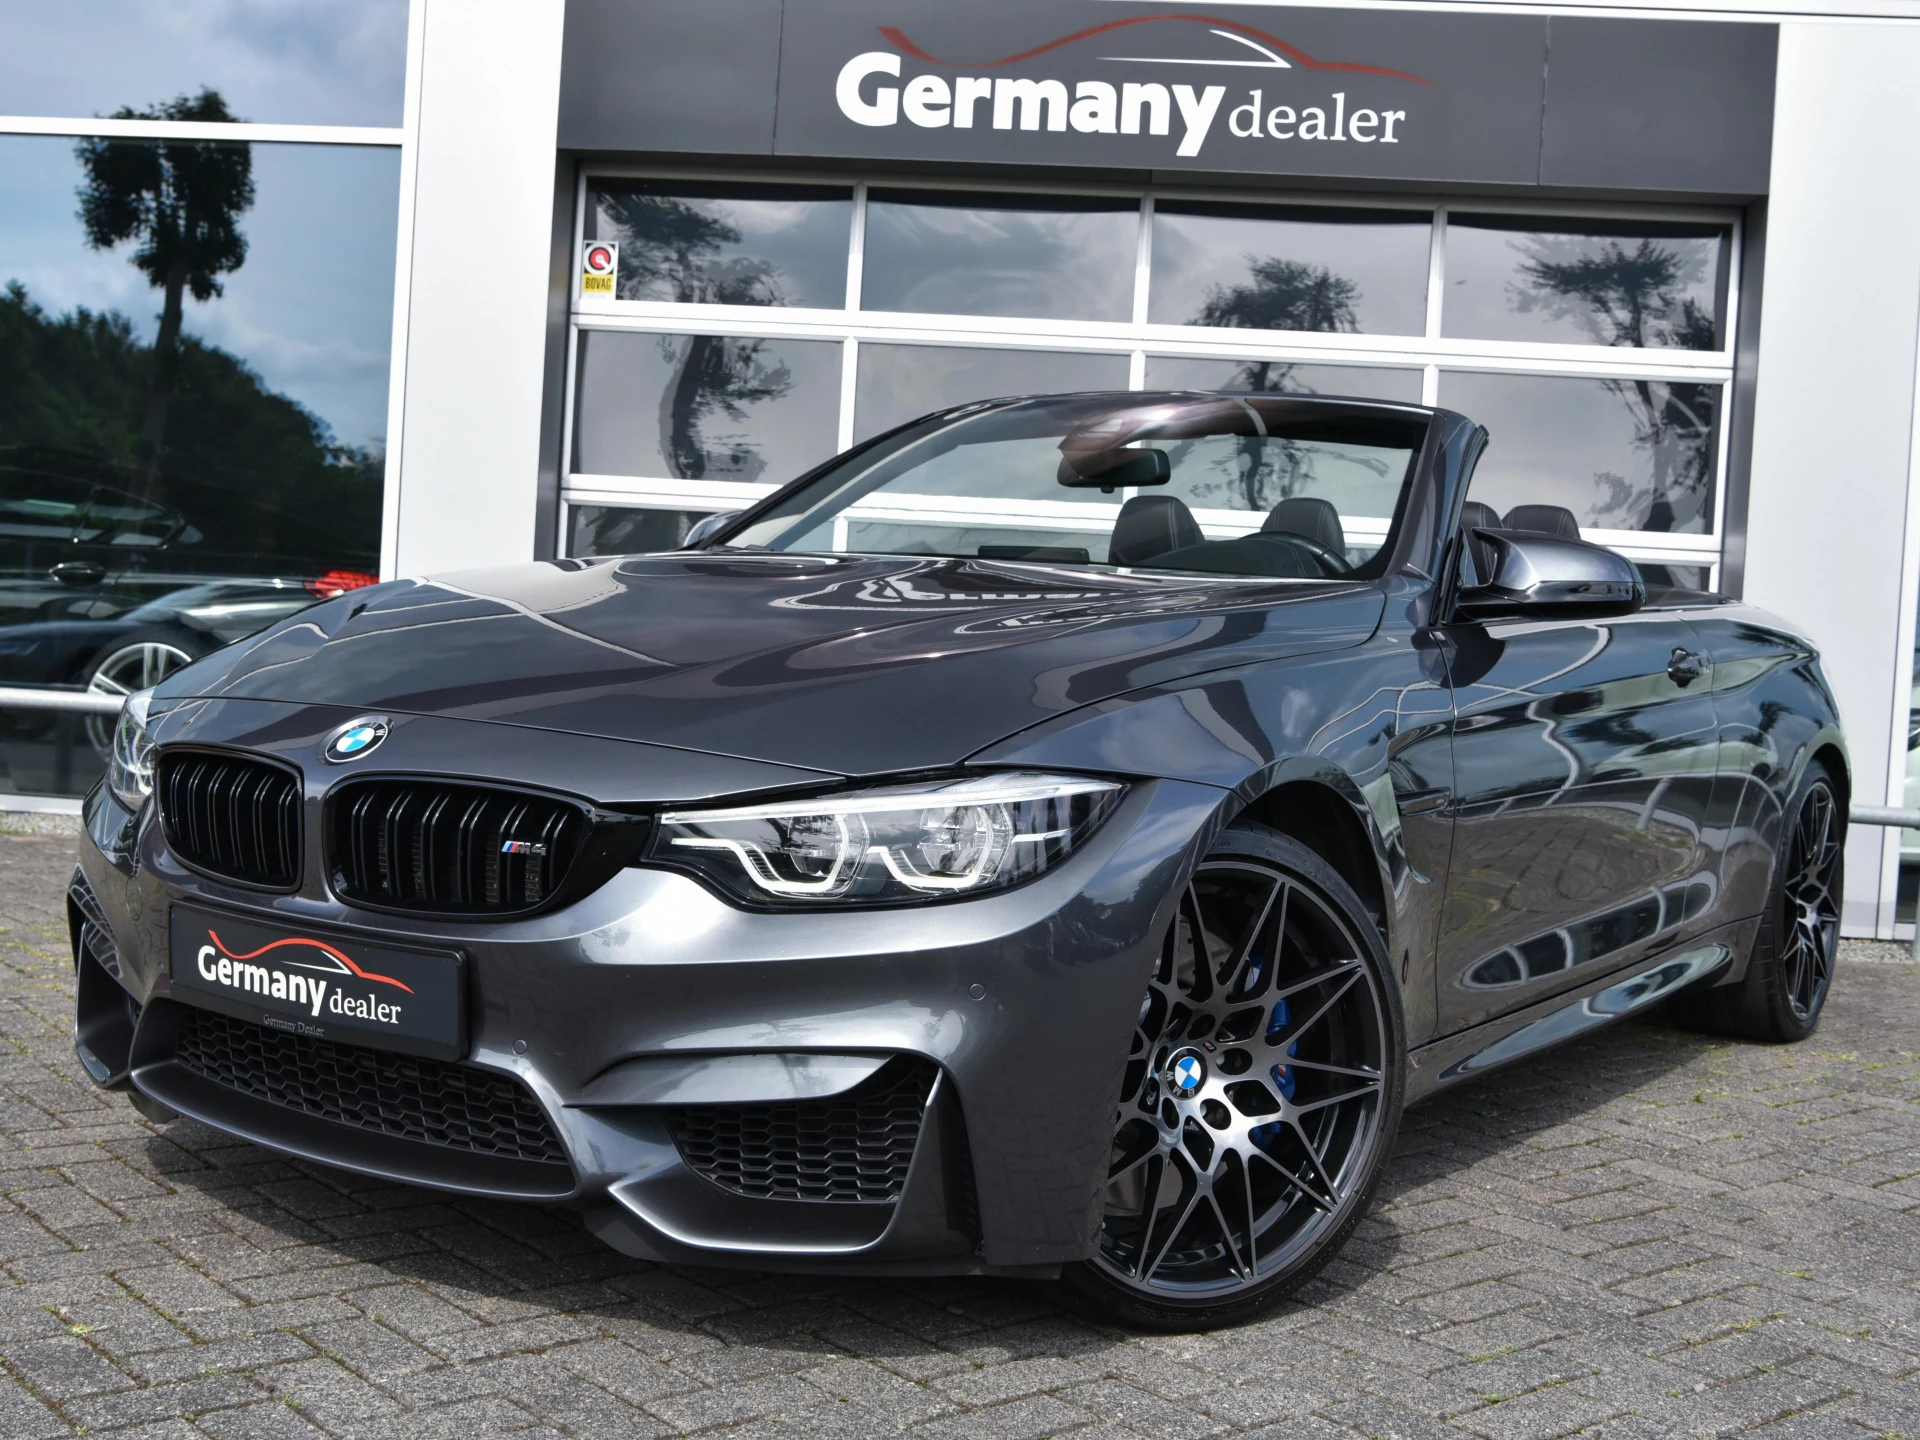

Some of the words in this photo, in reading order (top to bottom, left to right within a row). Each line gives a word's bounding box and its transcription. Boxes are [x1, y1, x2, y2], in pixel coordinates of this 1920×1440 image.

[836, 51, 1227, 157] Germany
[1228, 90, 1406, 144] dealer
[585, 277, 612, 290] BOVAG
[514, 841, 547, 856] M4
[197, 945, 327, 1017] Germany
[328, 988, 402, 1024] dealer
[263, 1013, 297, 1033] Germany
[297, 1021, 325, 1037] Dealer
[1166, 1070, 1196, 1098] BMW
